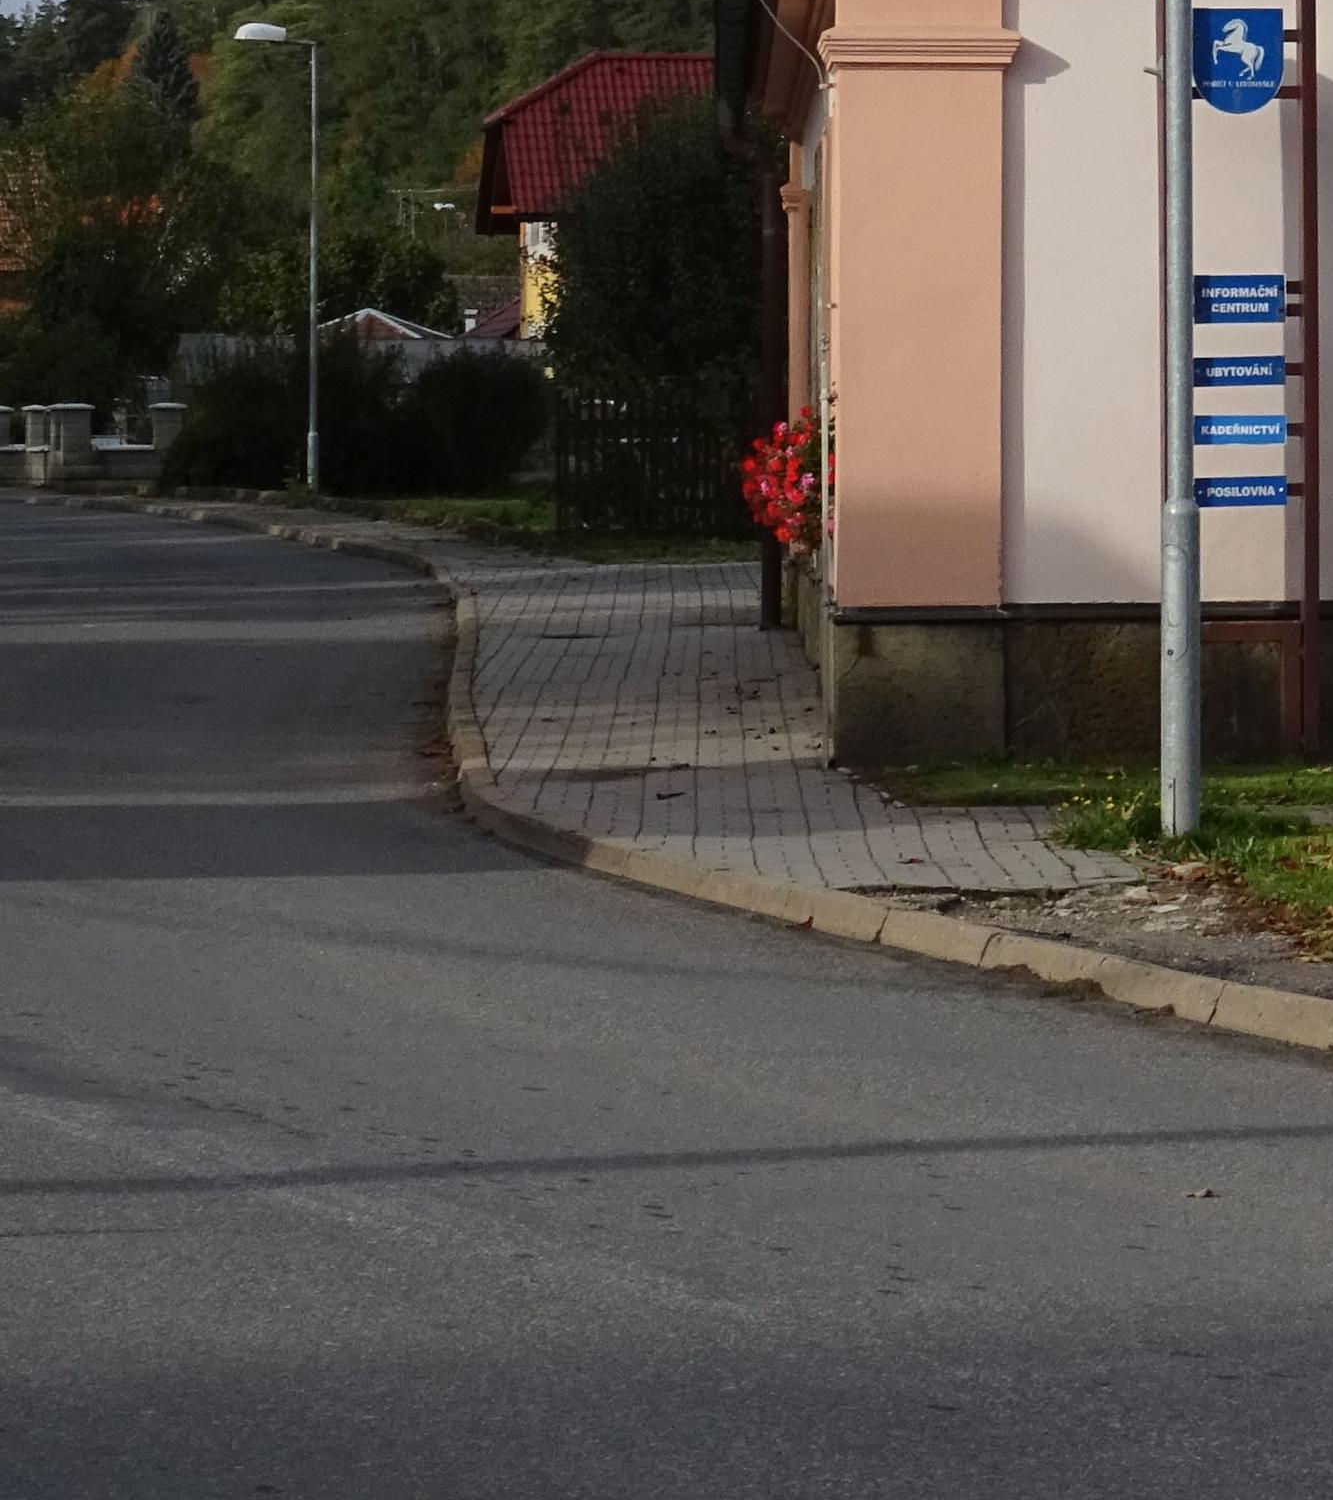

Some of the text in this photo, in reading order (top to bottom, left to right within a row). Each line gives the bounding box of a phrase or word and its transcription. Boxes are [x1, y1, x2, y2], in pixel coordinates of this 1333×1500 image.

[1201, 284, 1278, 298] INFORMAČNÍ
[1211, 302, 1269, 313] CENTRUM
[1206, 363, 1273, 377] UBYTOVÁNÍ
[1201, 423, 1280, 435] KADEŘNICTVÍ
[1206, 485, 1276, 497] POSILOVNA
